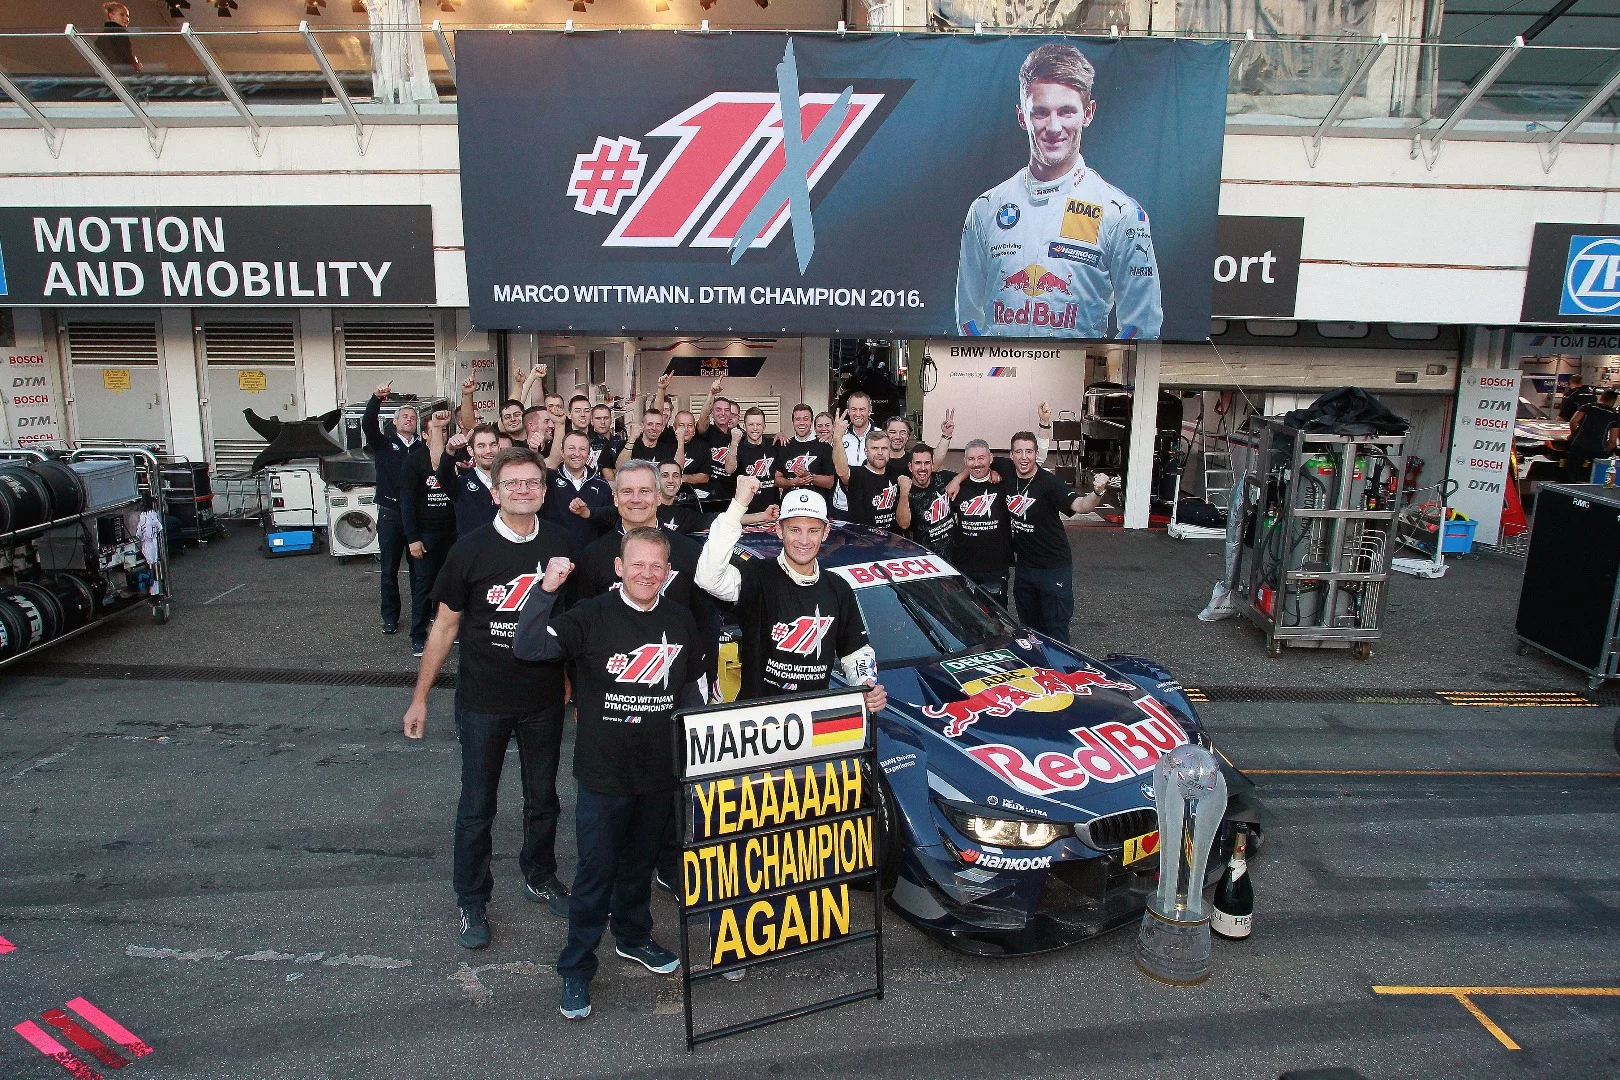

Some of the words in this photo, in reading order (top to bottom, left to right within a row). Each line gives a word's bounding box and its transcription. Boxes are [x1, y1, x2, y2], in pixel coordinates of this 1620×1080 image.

[1067, 200, 1101, 219] ADAC
[33, 215, 225, 253] MOTION
[44, 261, 145, 297] AND
[162, 260, 392, 298] MOBILITY
[493, 284, 570, 303] MARCO
[573, 285, 695, 304] WITTMANN.
[699, 286, 746, 304] DTM
[750, 287, 866, 307] CHAMPION
[870, 289, 925, 308] 2016.
[993, 301, 1030, 325] Red
[1033, 302, 1078, 329] Bull
[1551, 335, 1587, 348] TOM
[9, 355, 44, 365] BOSCH
[950, 346, 985, 358] BMW
[989, 347, 1061, 360] Motorsport
[472, 359, 495, 368] BOSCH
[12, 376, 47, 387] DTM
[1480, 377, 1514, 387] BOSCH
[13, 394, 49, 405] BOSCH
[1478, 399, 1511, 411] DTM
[17, 415, 51, 427] DTM
[1474, 417, 1509, 429] BOSCH
[1472, 439, 1506, 452] DTM
[1470, 458, 1503, 470] BOSCH
[1467, 479, 1501, 493] DTM
[848, 558, 941, 583] BOSCH
[490, 628, 507, 638] DTM
[767, 658, 793, 671] MARCO
[946, 651, 1014, 670] DEKRA
[765, 665, 781, 677] DTM
[980, 671, 1026, 687] ADAC
[605, 692, 637, 704] MARCO
[604, 701, 621, 710] DTM
[622, 703, 660, 712] CHAMPION
[689, 712, 804, 767] MARCO
[963, 728, 1138, 794] Red
[1091, 696, 1188, 774] Bull
[880, 757, 896, 768] BMW
[895, 753, 917, 762] Driving
[884, 760, 916, 774] Experience
[695, 757, 862, 838] YEAAAAAH
[683, 842, 739, 907] DTM
[744, 815, 874, 894] CHAMPION
[712, 883, 850, 965] AGAIN
